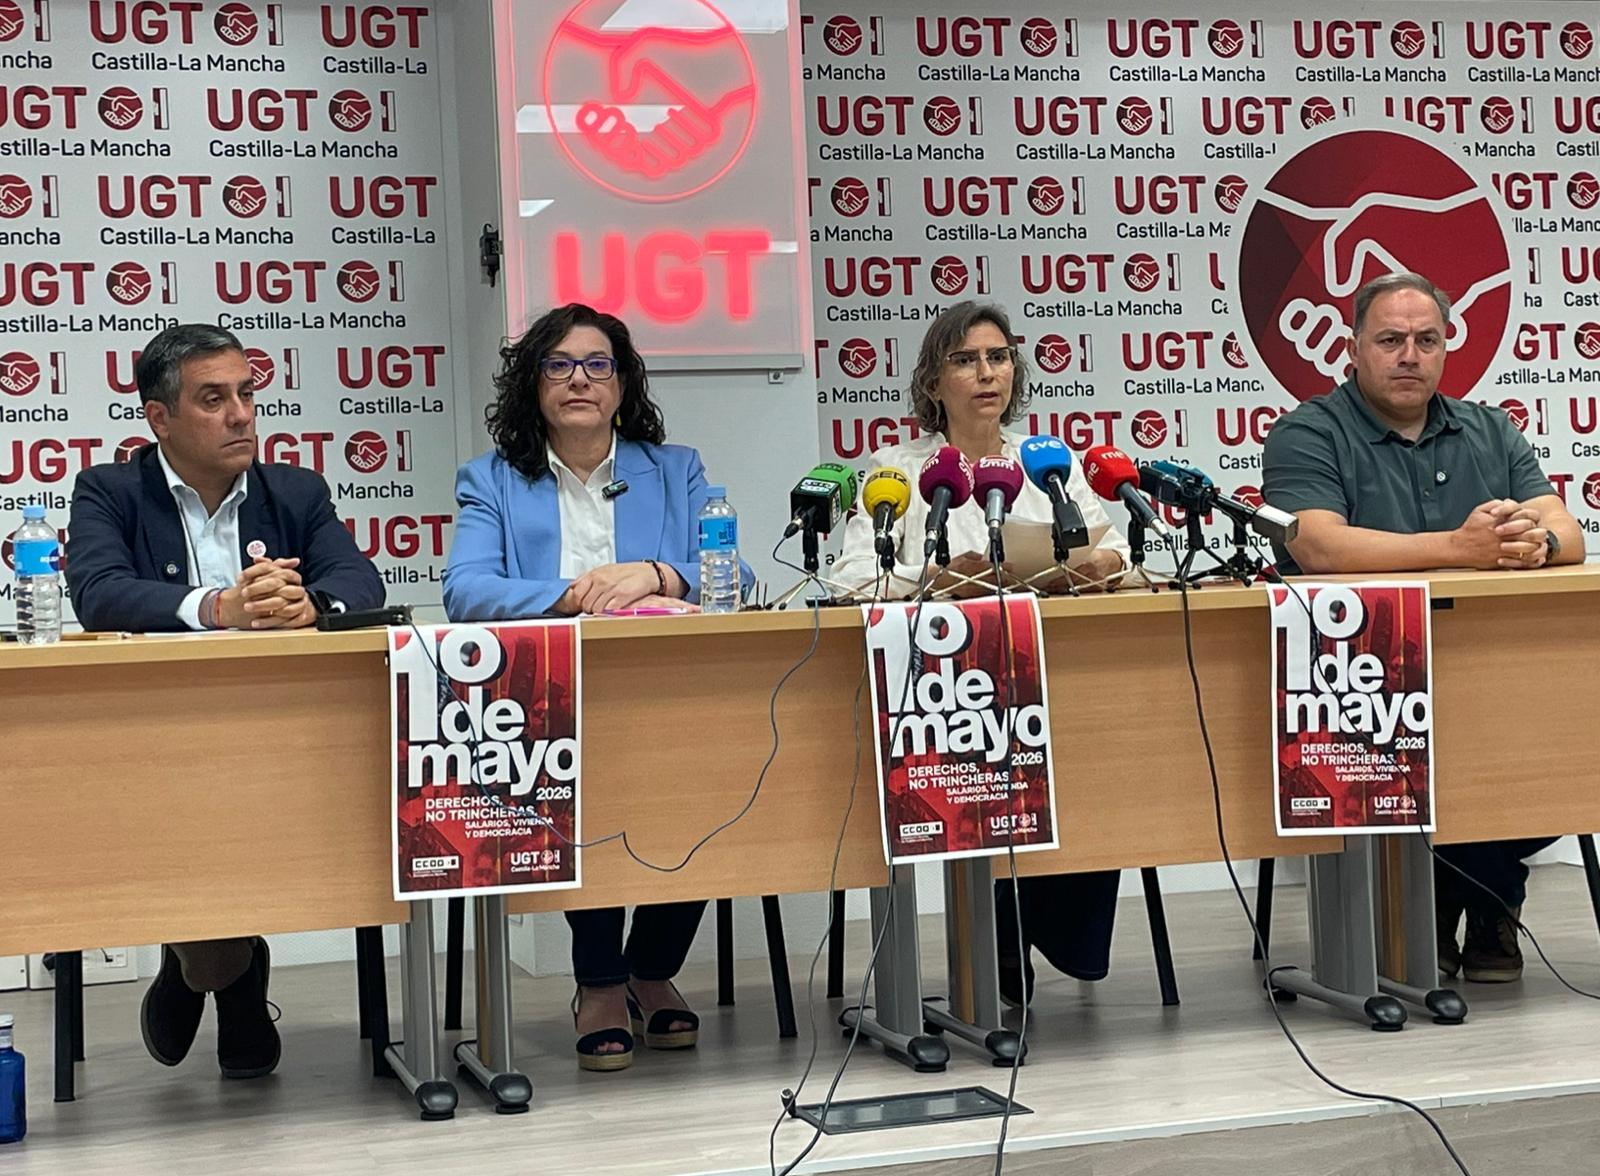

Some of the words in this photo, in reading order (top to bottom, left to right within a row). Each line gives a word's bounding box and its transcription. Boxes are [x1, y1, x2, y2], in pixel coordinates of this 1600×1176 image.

[90, 0, 203, 44] UGT
[320, 5, 429, 48] UGT
[916, 17, 1011, 56] UGT
[1107, 19, 1199, 57] UGT
[1293, 20, 1381, 59] UGT
[1466, 22, 1551, 58] UGT
[0, 51, 52, 69] ncha
[91, 52, 201, 71] Castilla-La
[206, 54, 285, 72] Mancha
[323, 56, 427, 75] Castilla-La
[817, 64, 886, 80] Mancha
[918, 64, 1010, 81] Castilla-La
[1014, 65, 1080, 81] Mancha
[1110, 66, 1197, 81] Castilla-La
[1202, 66, 1265, 82] Mancha
[1296, 66, 1381, 82] Castilla-La
[1385, 66, 1447, 82] Mancha
[1468, 66, 1551, 82] Castilla-La
[0, 86, 87, 129] GT
[206, 88, 318, 131] UGT
[817, 96, 914, 136] UGT
[1014, 96, 1107, 136] UGT
[1201, 96, 1292, 135] UGT
[0, 140, 85, 157] stilla-La
[90, 139, 171, 157] Mancha
[209, 140, 316, 158] Castilla-La
[321, 141, 398, 158] Mancha
[819, 143, 913, 160] Castilla-La
[917, 143, 984, 160] Mancha
[1017, 143, 1106, 160] Castilla-La
[1110, 143, 1175, 160] Mancha
[1475, 141, 1536, 157] Mancha
[98, 176, 211, 218] UGT
[329, 176, 437, 218] UGT
[923, 177, 1018, 216] UGT
[1114, 176, 1206, 215] UGT
[824, 225, 893, 241] Mancha
[926, 224, 1017, 241] Castilla-La
[1021, 223, 1087, 240] Mancha
[1117, 222, 1205, 239] Castilla-La
[1561, 217, 1600, 233] Manc
[0, 228, 61, 245] ancha
[100, 227, 209, 246] Castilla-La
[215, 227, 294, 246] Mancha
[331, 226, 436, 245] Castilla-La
[215, 261, 326, 304] UGT
[553, 232, 770, 322] UGT
[825, 257, 921, 297] UGT
[1021, 254, 1115, 293] UGT
[826, 304, 920, 321] Castilla-La
[1024, 301, 1113, 318] Castilla-La
[1118, 299, 1183, 317] Mancha
[0, 314, 93, 333] astilla-La
[99, 314, 178, 332] Mancha
[218, 312, 324, 330] Castilla-La
[330, 311, 406, 329] Mancha
[1122, 331, 1213, 371] UGT
[1513, 323, 1565, 362] GT
[337, 346, 445, 389] UGT
[1568, 368, 1600, 383] Man
[832, 386, 900, 404] Mancha
[1030, 382, 1095, 398] Mancha
[1124, 378, 1212, 396] Castilla-La
[1216, 378, 1264, 394] Manc
[254, 399, 301, 416] ncha
[339, 396, 444, 414] Castilla-La
[1217, 407, 1277, 446] UG
[255, 432, 334, 476] GT
[1028, 439, 1062, 451] tve
[337, 481, 414, 500] Mancha
[1313, 641, 1384, 693] de
[916, 657, 995, 714] de
[440, 686, 526, 743] de
[1286, 691, 1429, 744] mayo
[888, 704, 1048, 763] mayo
[1395, 737, 1425, 749] 2026
[1010, 751, 1044, 765] 2026
[1301, 743, 1368, 754] DERECHOS,
[408, 737, 577, 796] mayo
[908, 762, 980, 778] DERECHOS,
[1301, 755, 1319, 766] NO
[536, 785, 573, 801] 2026
[909, 779, 928, 790] NO
[1374, 797, 1399, 808] UGT
[425, 812, 446, 822] NO
[990, 816, 1017, 829] UGT
[465, 831, 471, 839] Y
[510, 852, 540, 866] UGT
